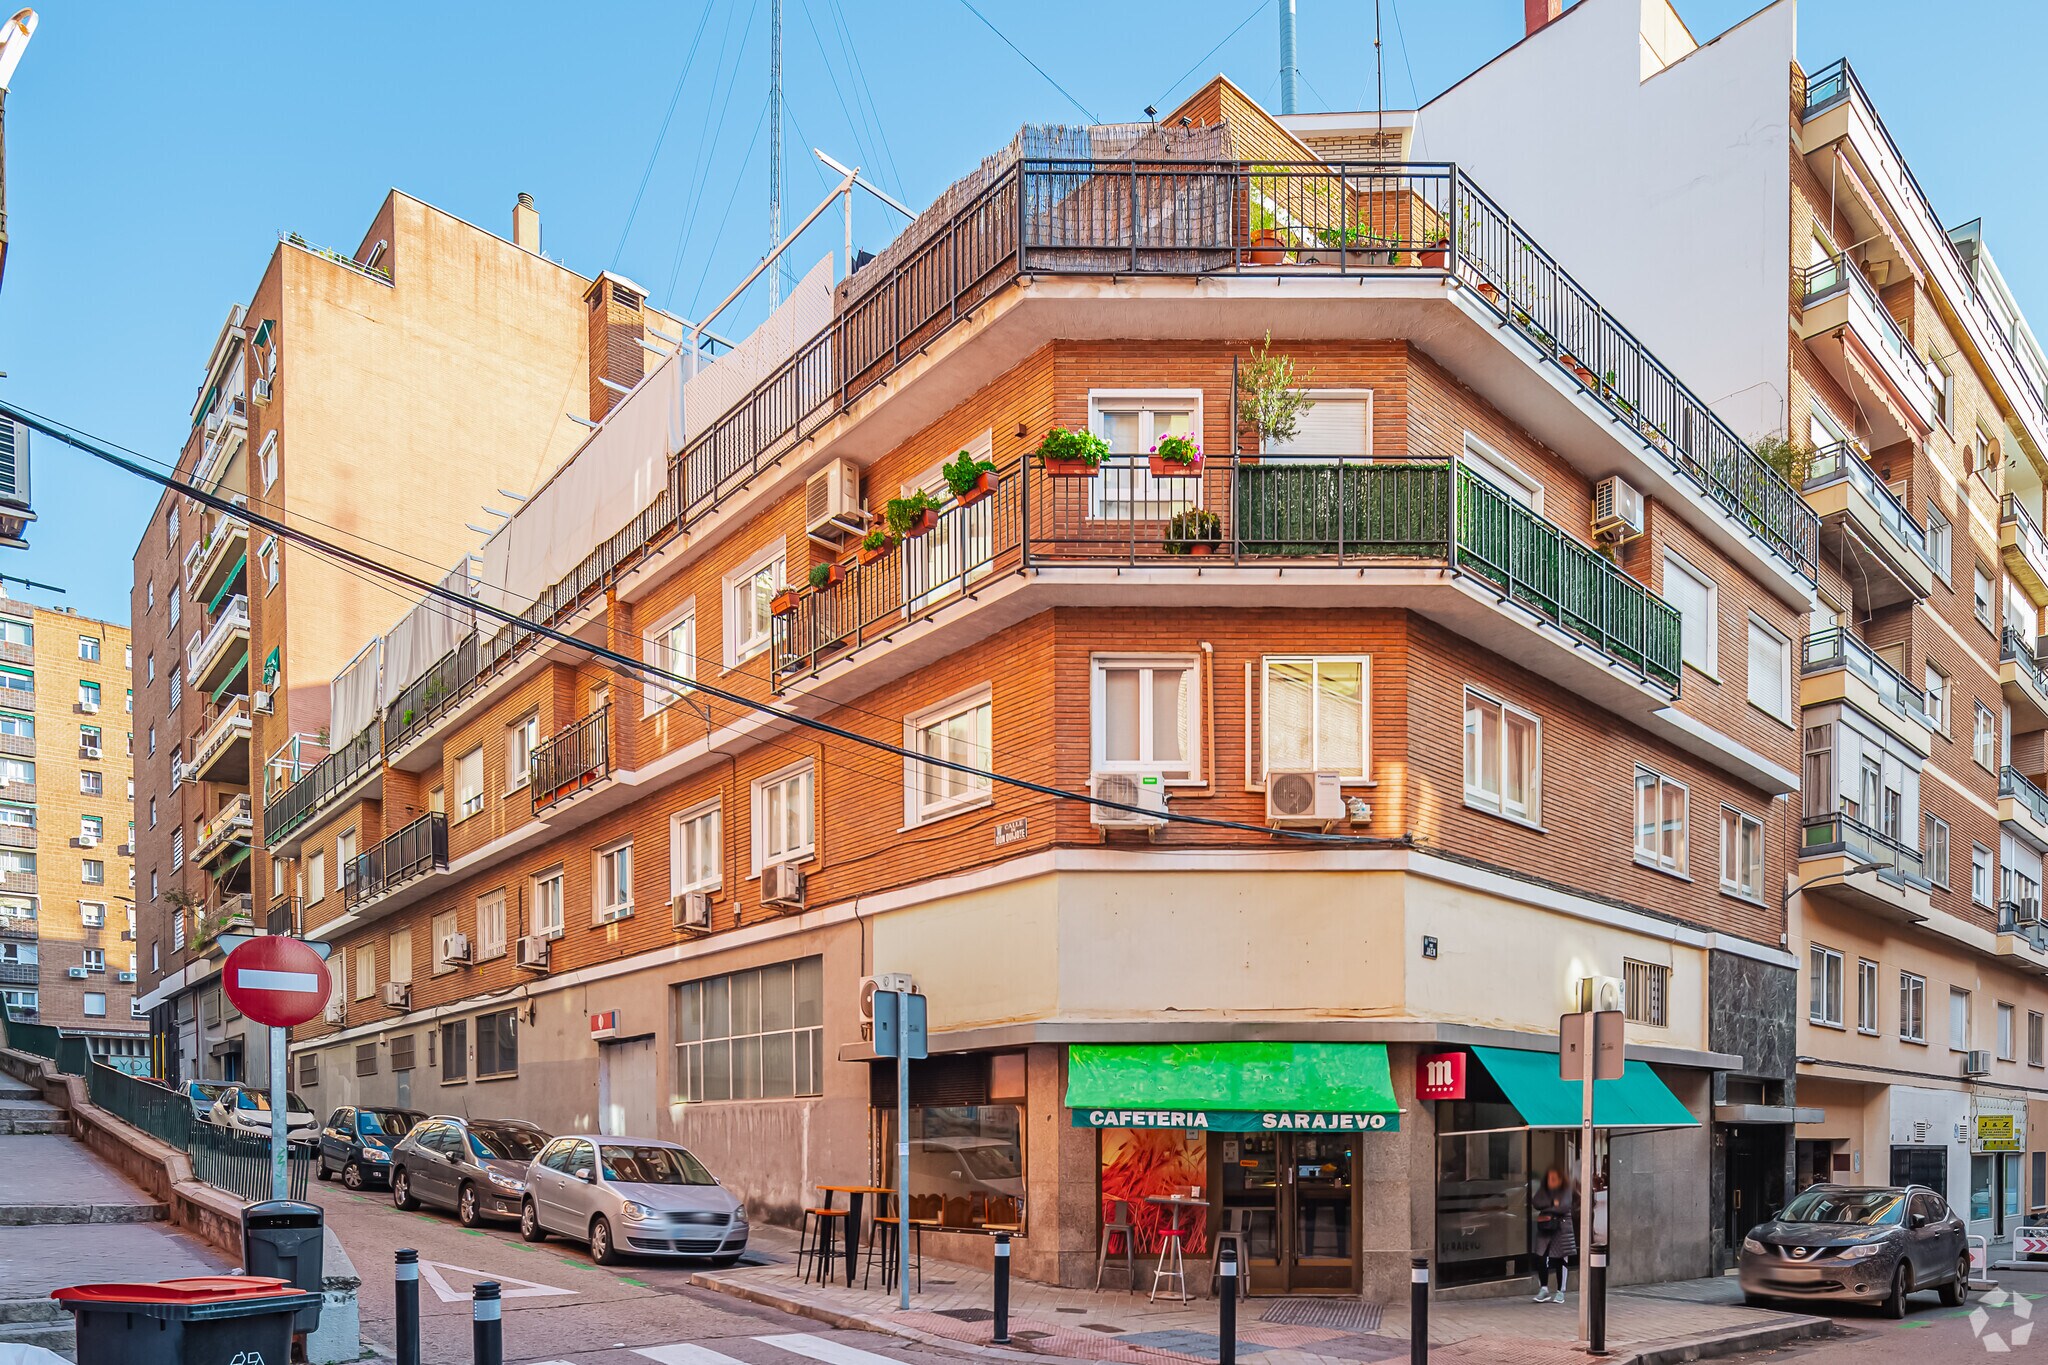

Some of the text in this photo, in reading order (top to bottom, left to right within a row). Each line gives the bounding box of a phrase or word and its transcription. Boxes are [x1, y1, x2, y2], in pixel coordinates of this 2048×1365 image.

[1004, 820, 1023, 830] CALLE
[1089, 1110, 1386, 1129] CAFETERIA SARAJEVO
